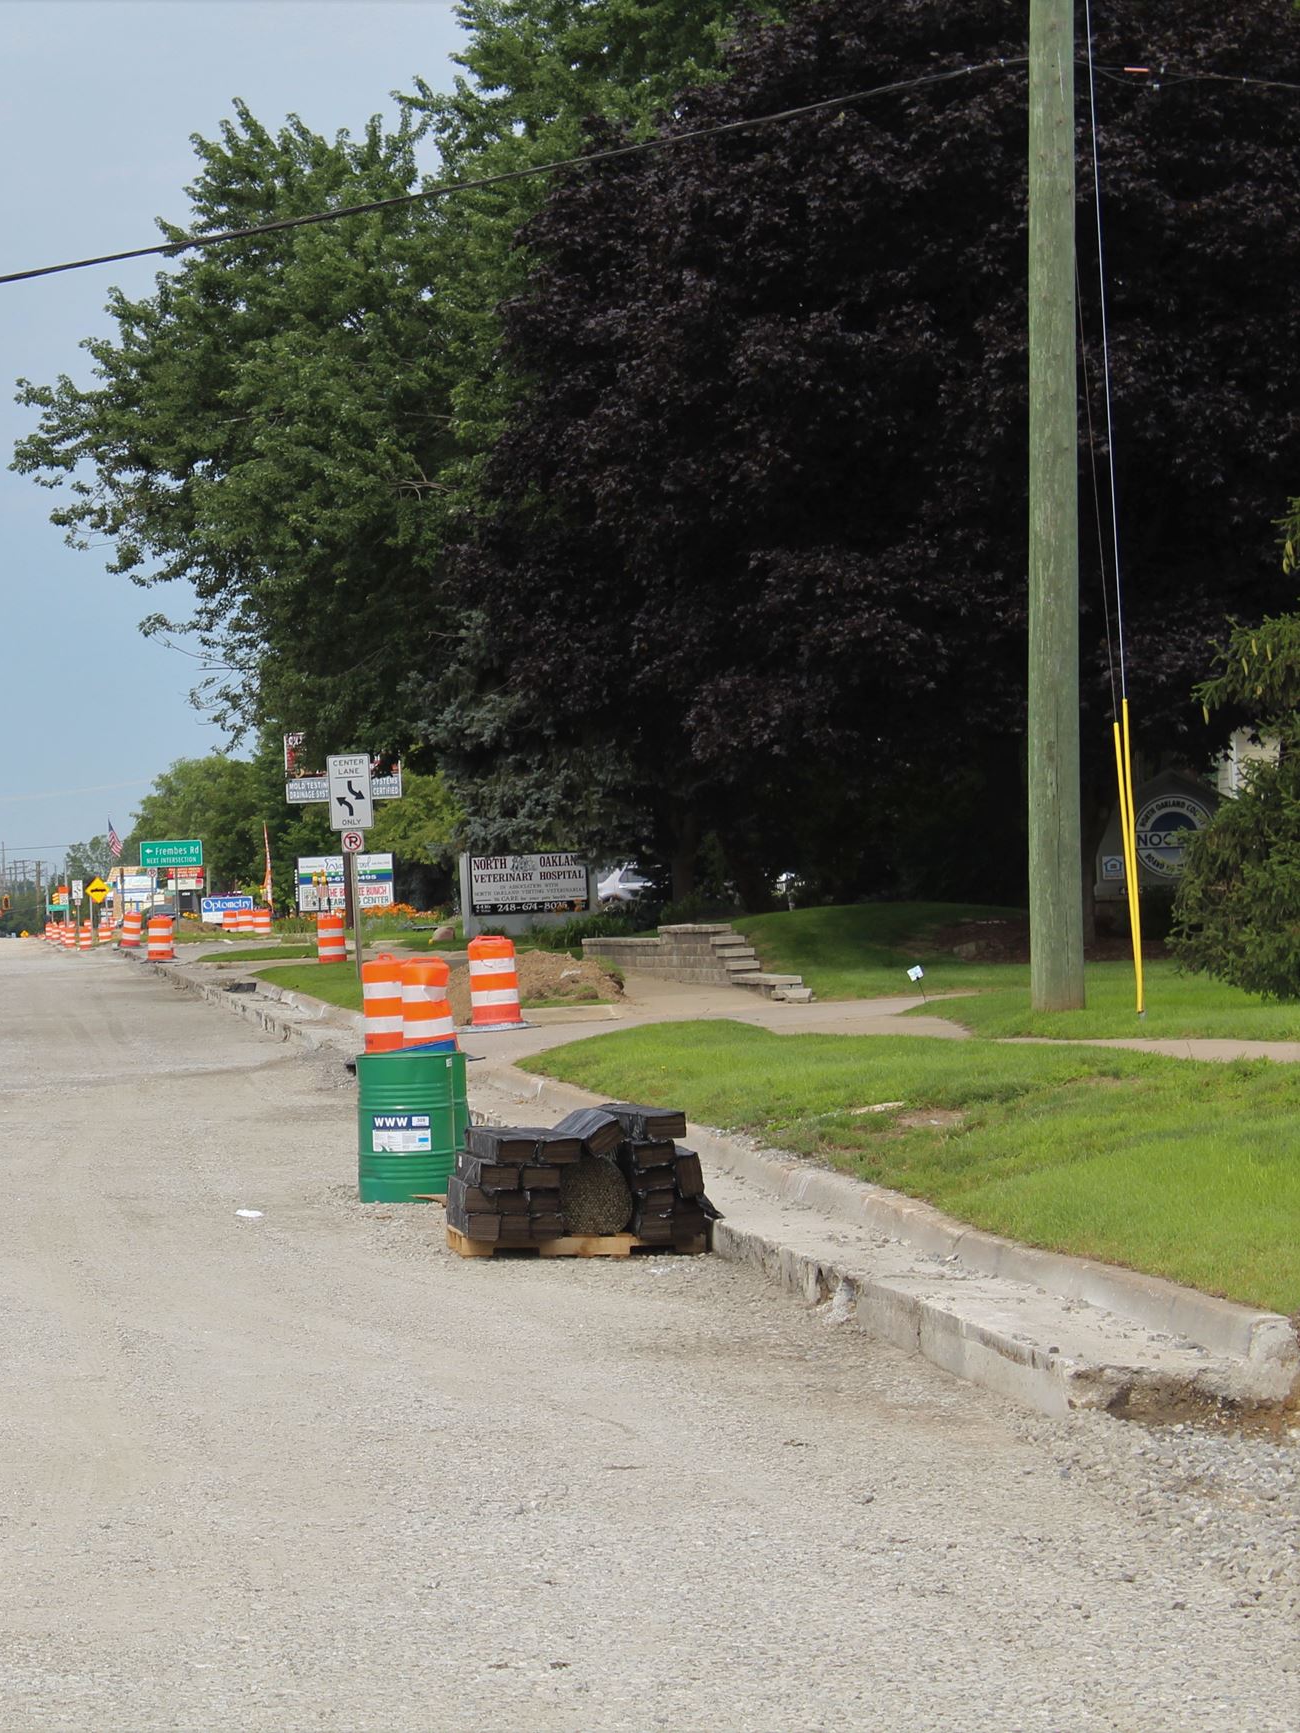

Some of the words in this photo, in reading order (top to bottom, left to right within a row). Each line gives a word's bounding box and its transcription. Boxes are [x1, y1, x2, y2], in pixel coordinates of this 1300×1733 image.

[333, 759, 364, 767] CENTER
[307, 781, 329, 789] TESTIN
[372, 777, 398, 785] SYSTEMS
[290, 790, 315, 799] DRAINAGE
[372, 786, 398, 795] CERTIFIED
[1156, 800, 1186, 811] OAKLAND
[342, 818, 361, 826] ONLY
[155, 846, 187, 855] Frembes
[189, 846, 199, 854] Rd
[473, 858, 507, 871] NORTH
[540, 855, 579, 868] OAKLAN
[474, 872, 534, 883] VETERINARY
[540, 870, 584, 880] HOSPITAL
[203, 899, 250, 911] Optometry
[363, 896, 389, 904] CENTER
[374, 1117, 408, 1127] WWW
